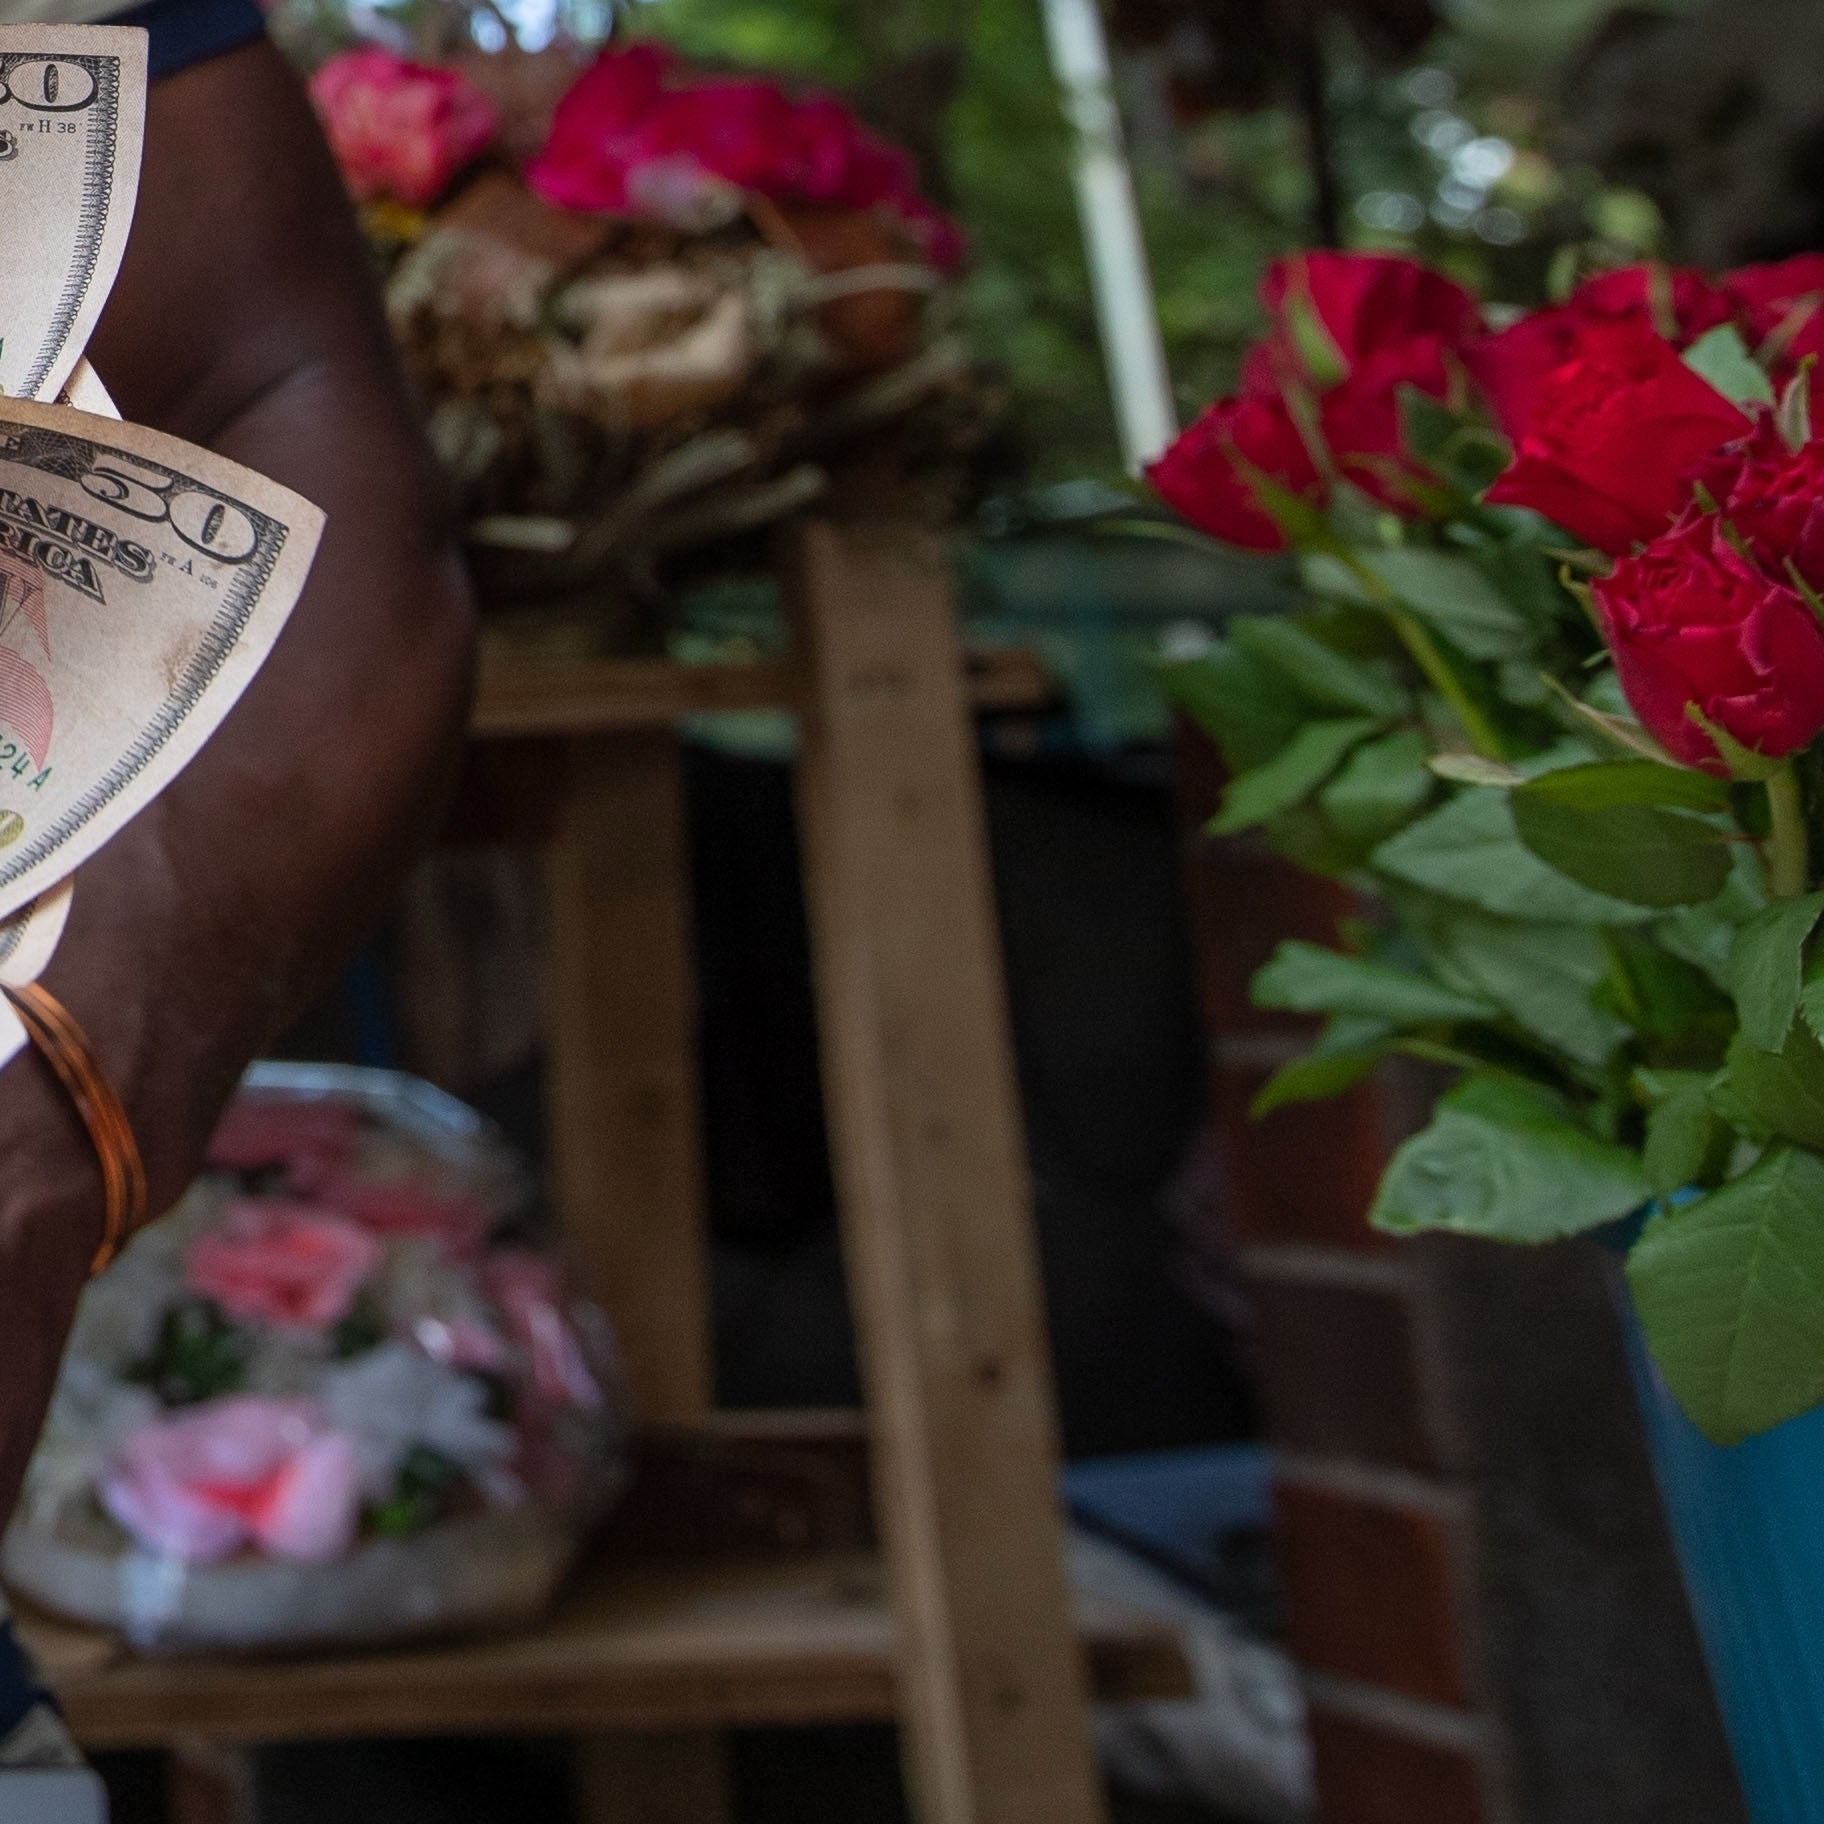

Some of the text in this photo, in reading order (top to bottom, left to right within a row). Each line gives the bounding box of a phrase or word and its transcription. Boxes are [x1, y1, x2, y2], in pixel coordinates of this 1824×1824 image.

[36, 120, 51, 133] H
[56, 122, 76, 134] 38
[80, 457, 265, 565] 50
[27, 766, 53, 792] A
